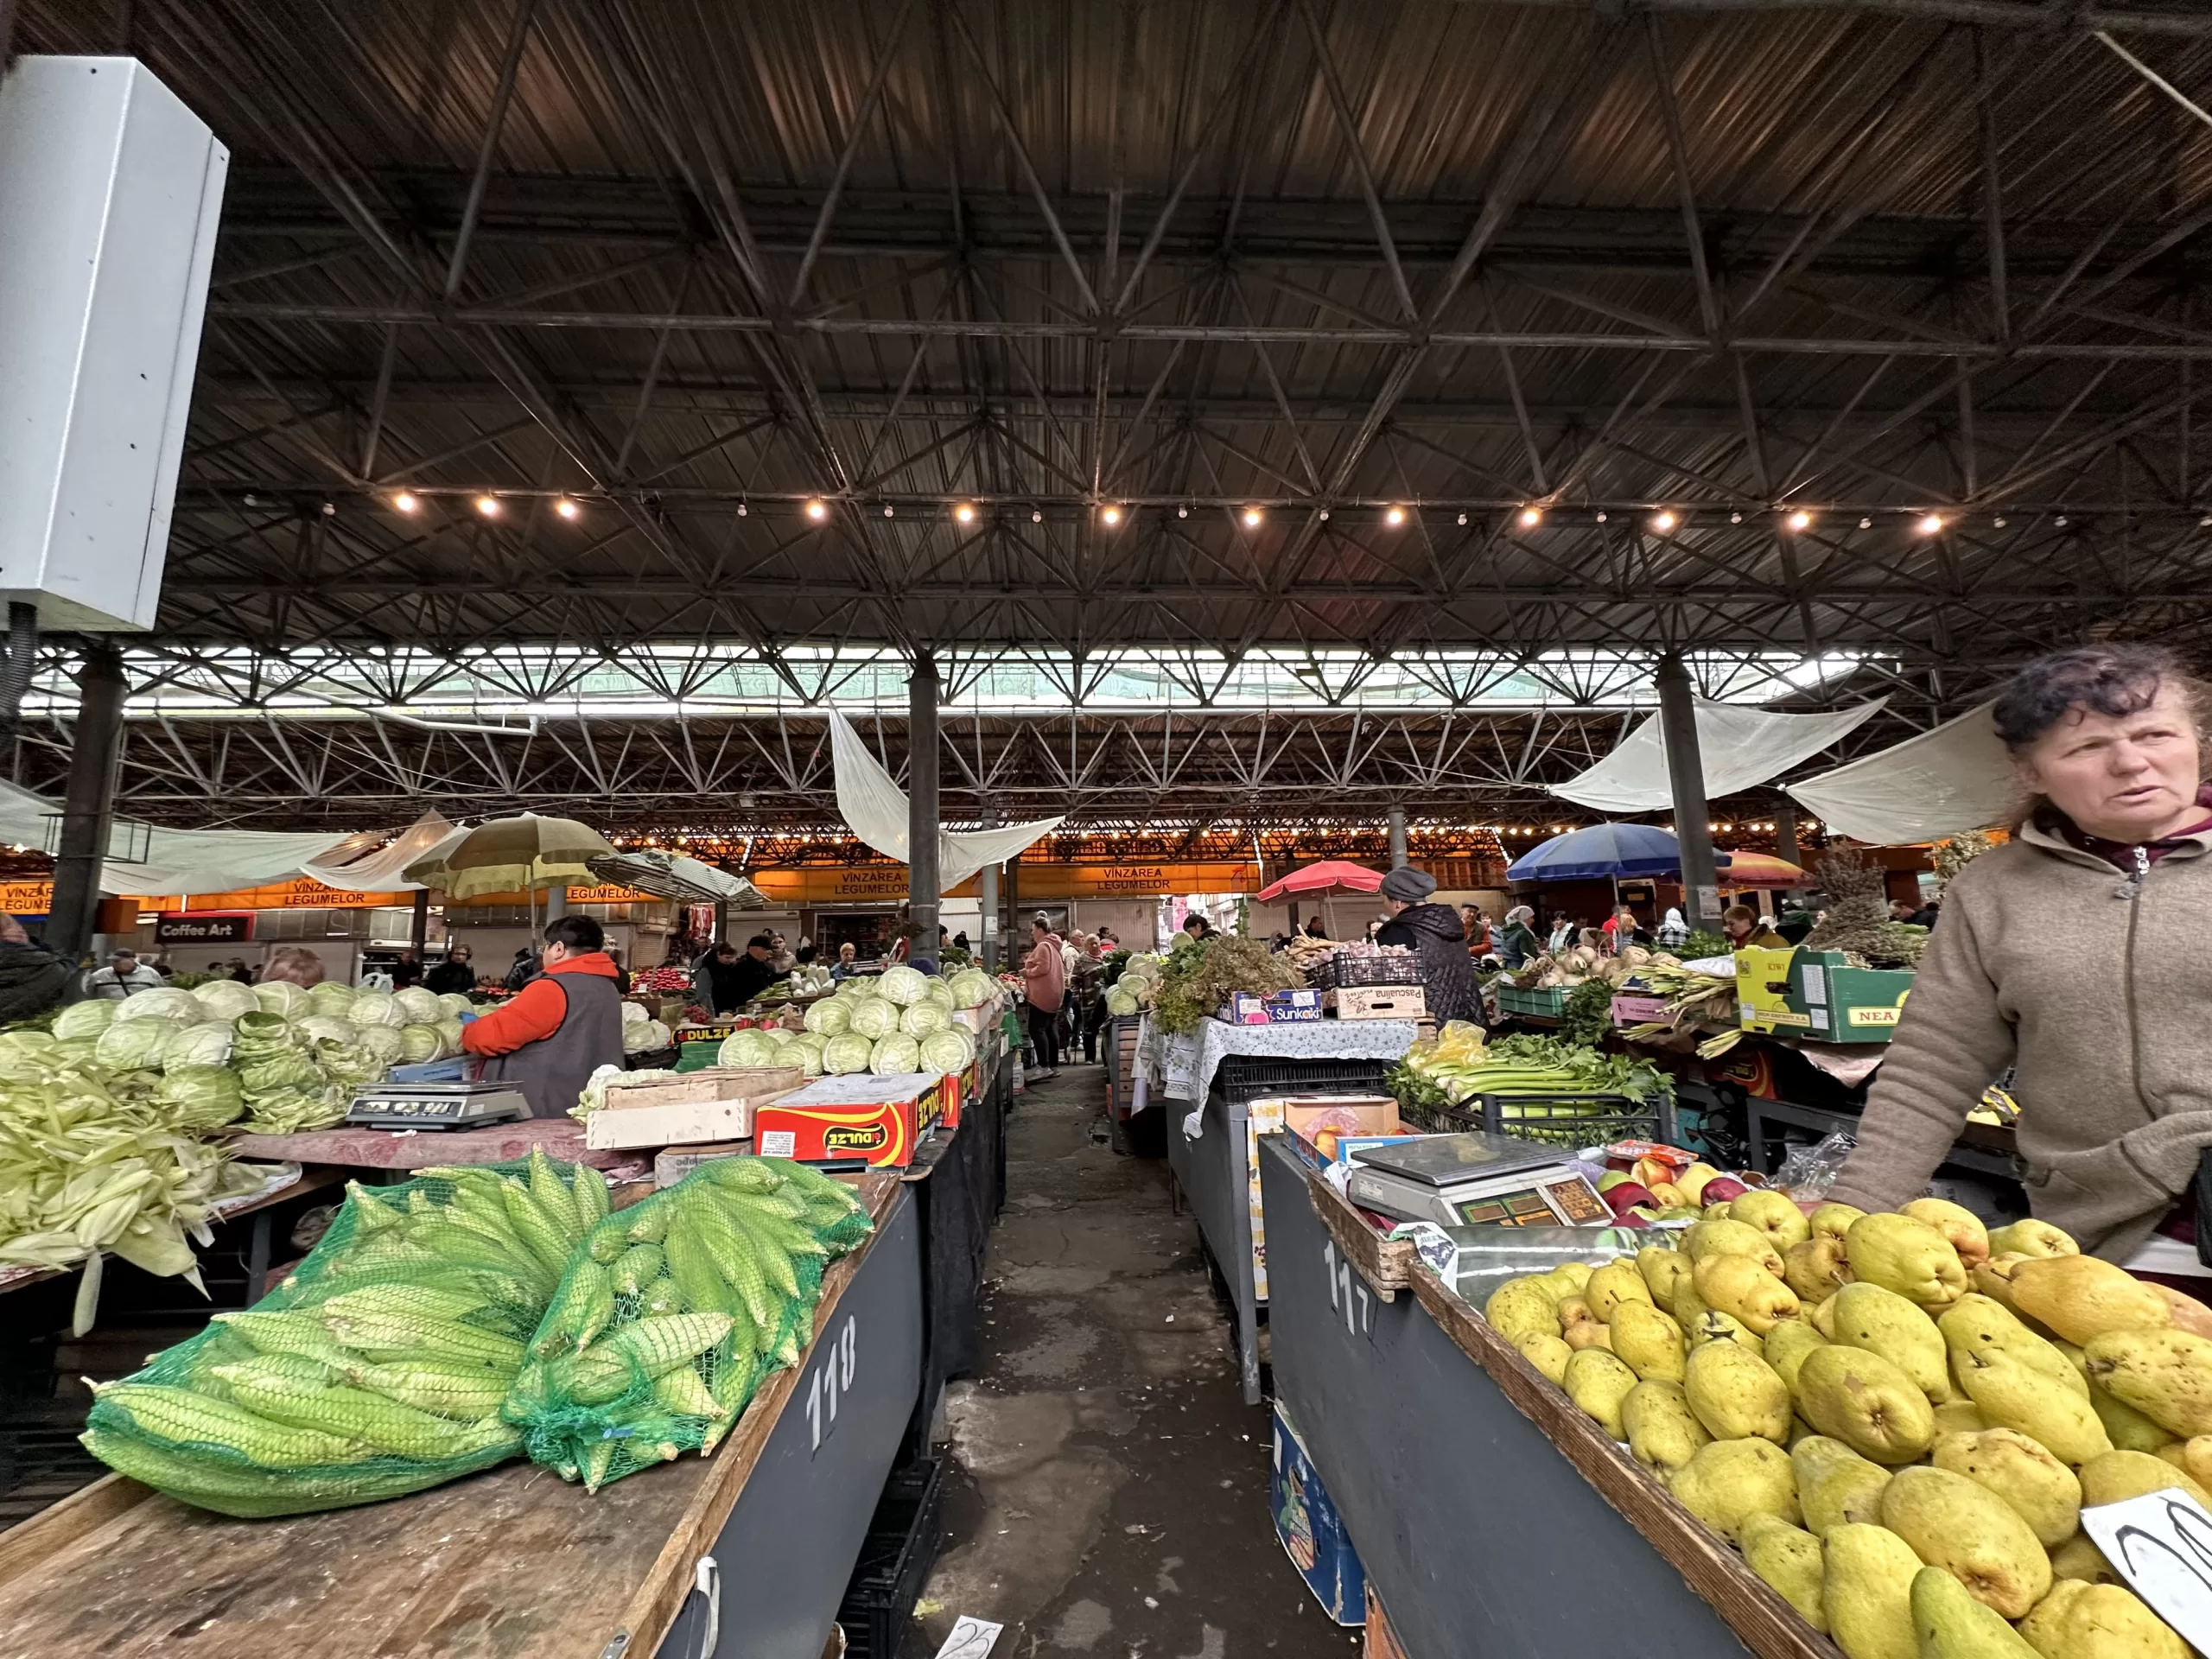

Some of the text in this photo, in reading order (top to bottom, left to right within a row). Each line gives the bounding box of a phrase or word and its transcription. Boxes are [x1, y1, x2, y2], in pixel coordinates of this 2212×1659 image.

[835, 884, 909, 894] LEGUMELOR
[1097, 880, 1170, 890] LEGUMELOR
[285, 893, 365, 905] LEGUMELOR
[161, 924, 232, 937] Coffee Art
[1276, 1007, 1319, 1020] Sunkaki
[1859, 1011, 1895, 1021] NEA
[1324, 1240, 1368, 1336] 117
[806, 1314, 856, 1452] 118
